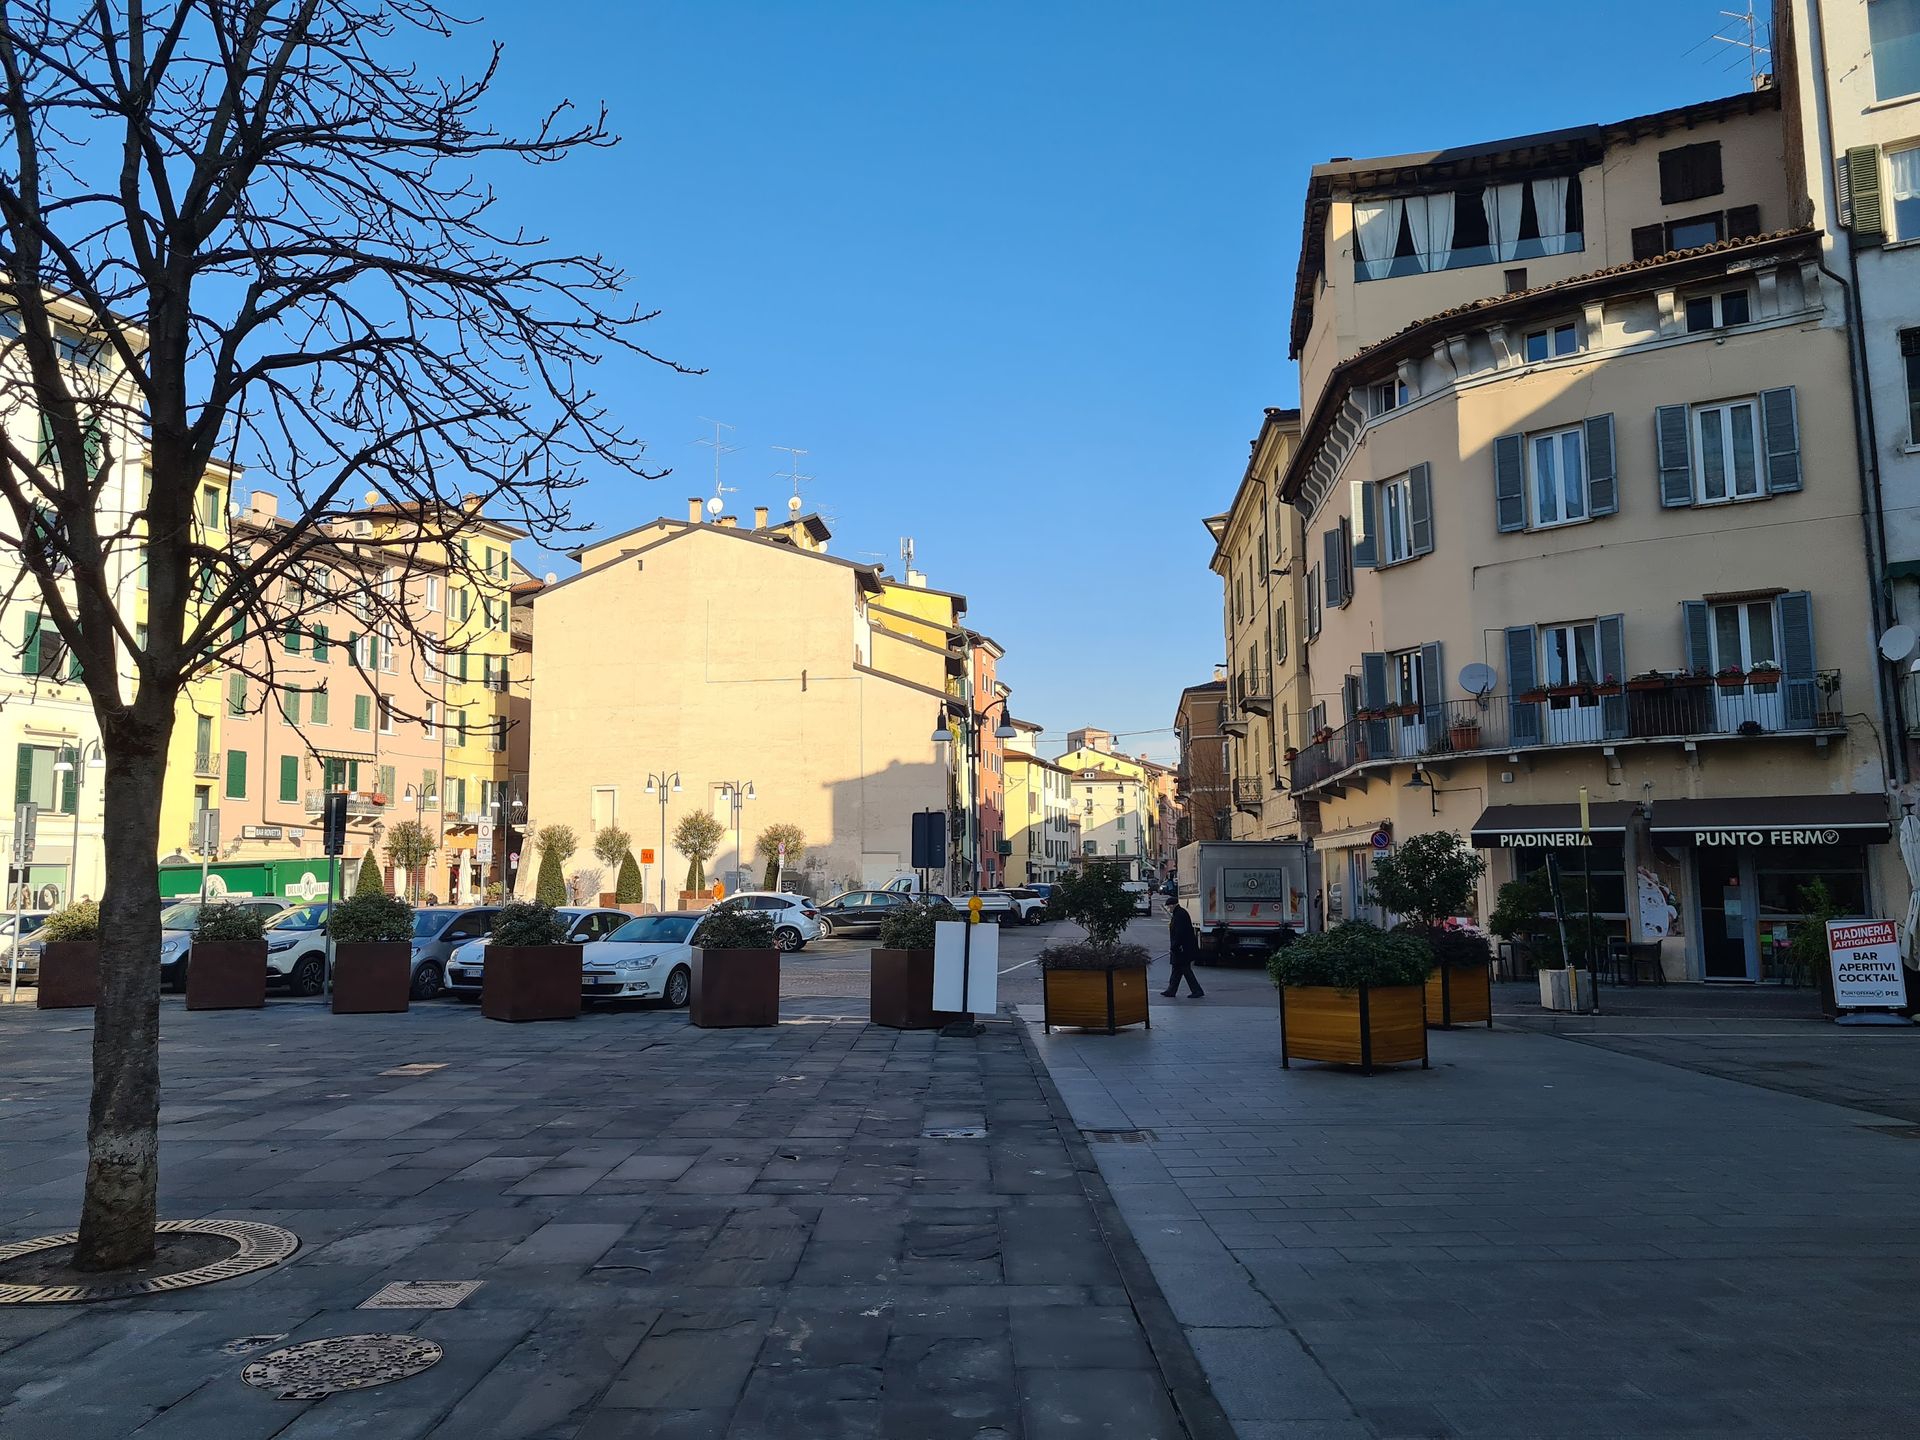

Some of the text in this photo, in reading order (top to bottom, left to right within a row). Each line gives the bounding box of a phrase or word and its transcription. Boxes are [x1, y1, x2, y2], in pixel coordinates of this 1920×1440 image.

[1500, 833, 1592, 847] PIADINERIA
[1695, 832, 1763, 846] PUNTO
[1833, 924, 1892, 940] PIADINERIA
[1835, 935, 1893, 948] ARTIGIANALE
[1853, 952, 1877, 960] BAR
[1839, 963, 1895, 971] APERITIVI
[1838, 974, 1899, 982] COCKTAIL
